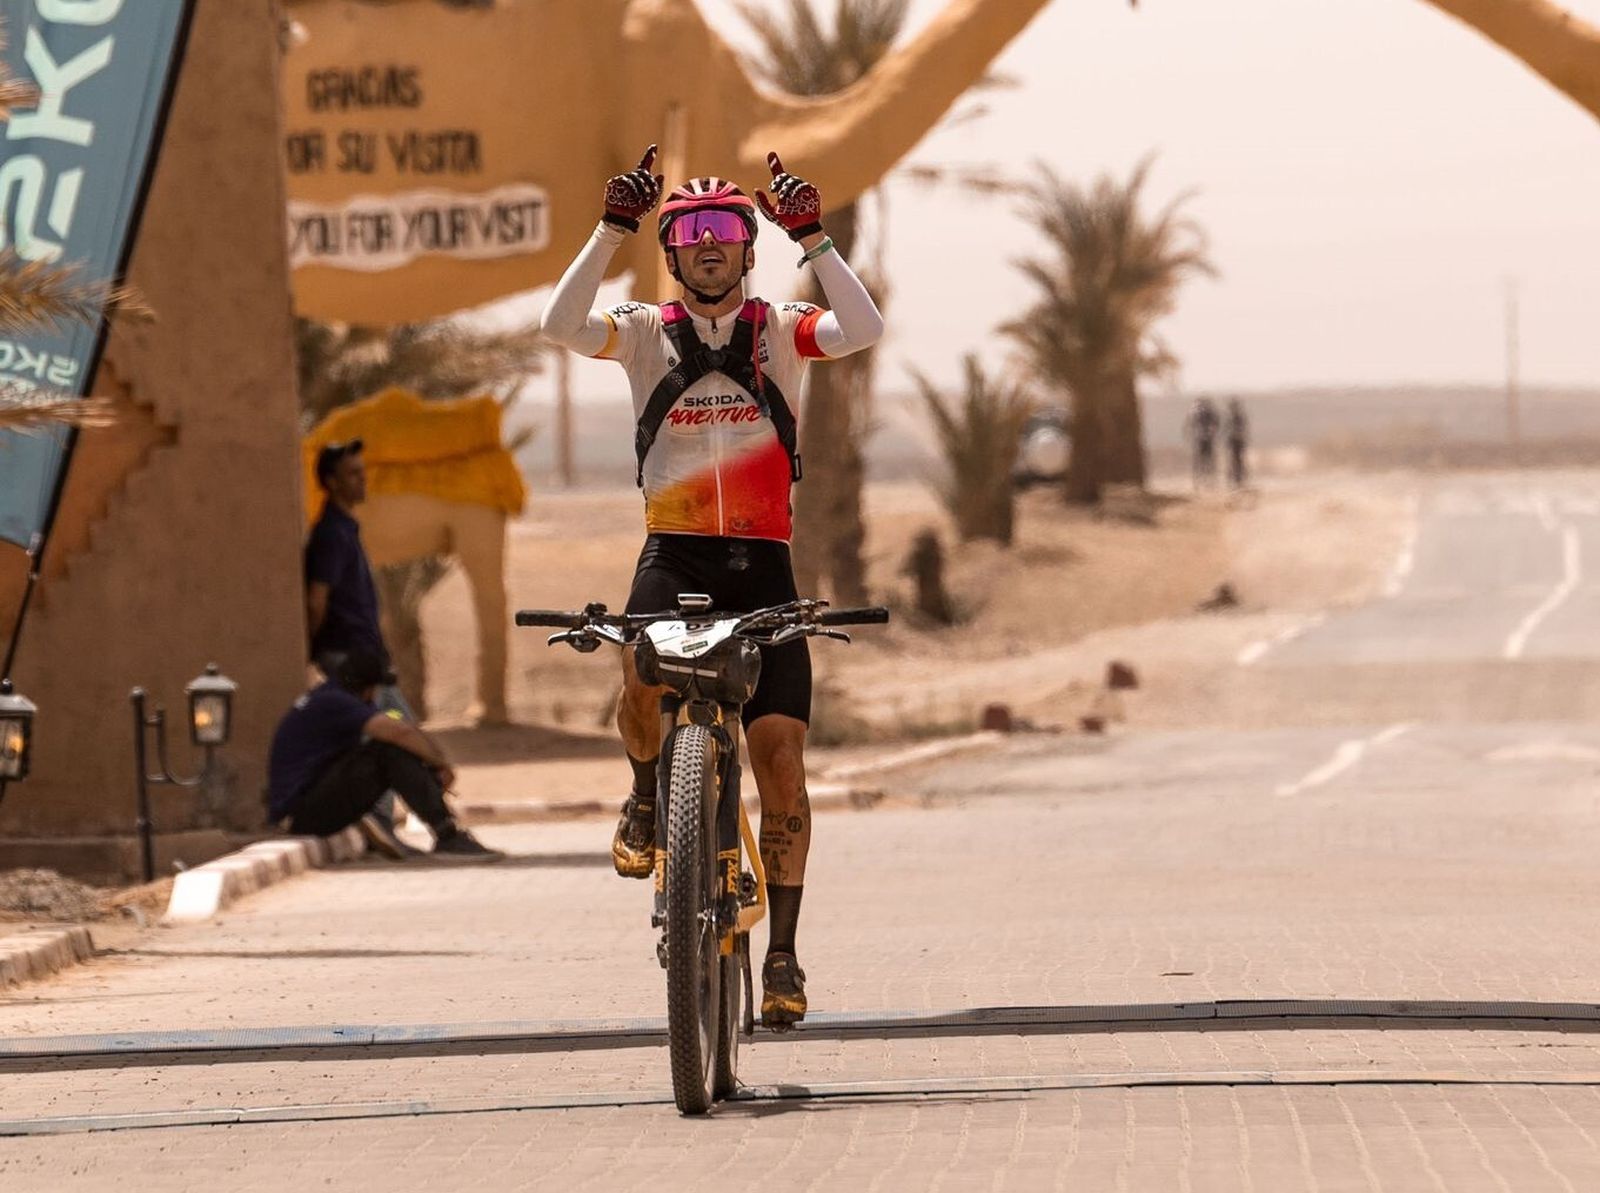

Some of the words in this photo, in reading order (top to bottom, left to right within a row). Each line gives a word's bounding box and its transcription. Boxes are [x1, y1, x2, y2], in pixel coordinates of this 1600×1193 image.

[287, 130, 326, 174] OR
[338, 131, 376, 174] SU
[386, 129, 482, 174] VISITA
[289, 215, 342, 255] YOU
[347, 210, 399, 255] FOR
[400, 206, 474, 251] YOUR
[472, 199, 543, 246] VISIT
[666, 404, 761, 427] ADVENTURE
[683, 394, 746, 407] SKODA
